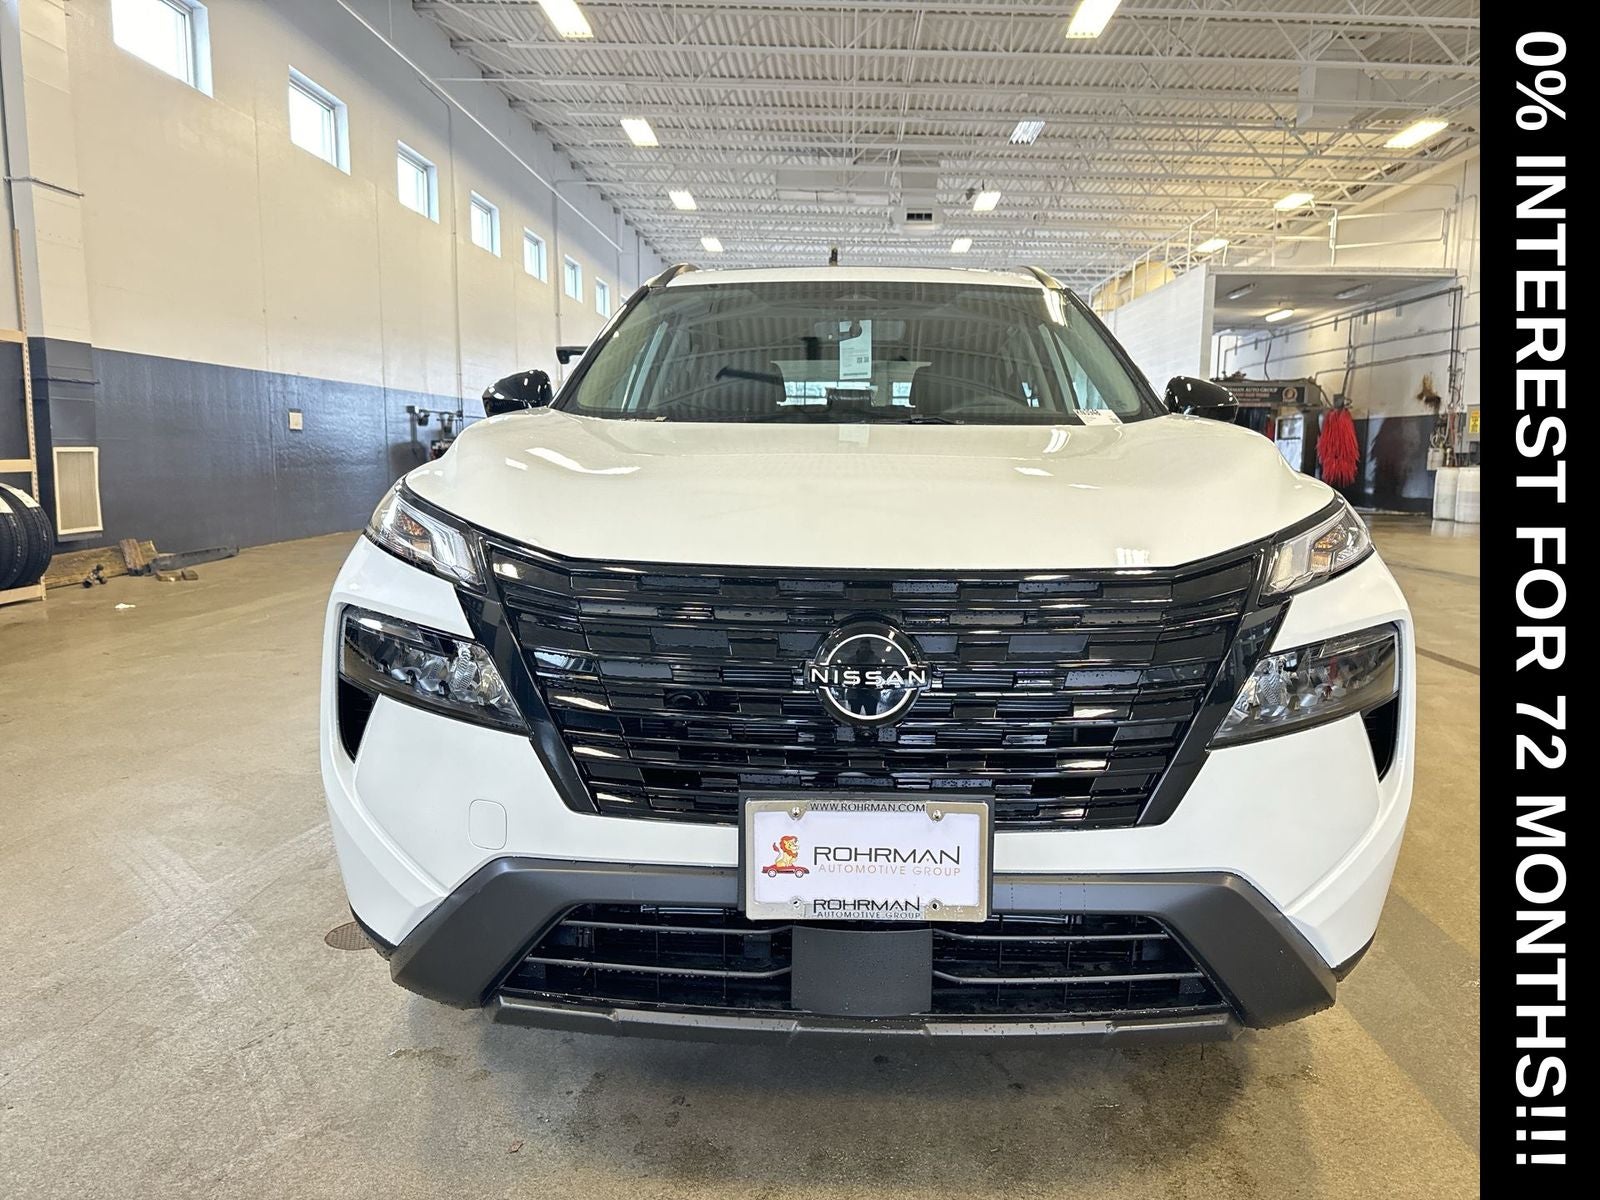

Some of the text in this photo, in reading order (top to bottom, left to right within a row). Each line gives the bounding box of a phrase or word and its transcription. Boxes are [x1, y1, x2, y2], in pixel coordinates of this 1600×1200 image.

[810, 668, 926, 685] NISSAN
[810, 802, 926, 813] WWW.ROHRMAN.COM
[813, 845, 961, 865] ROHRMAN
[818, 863, 961, 877] AUTOMOTIVE GROUP
[813, 896, 921, 913] ROHRMAN
[816, 911, 921, 919] AUTOMOTIVE GROUP
